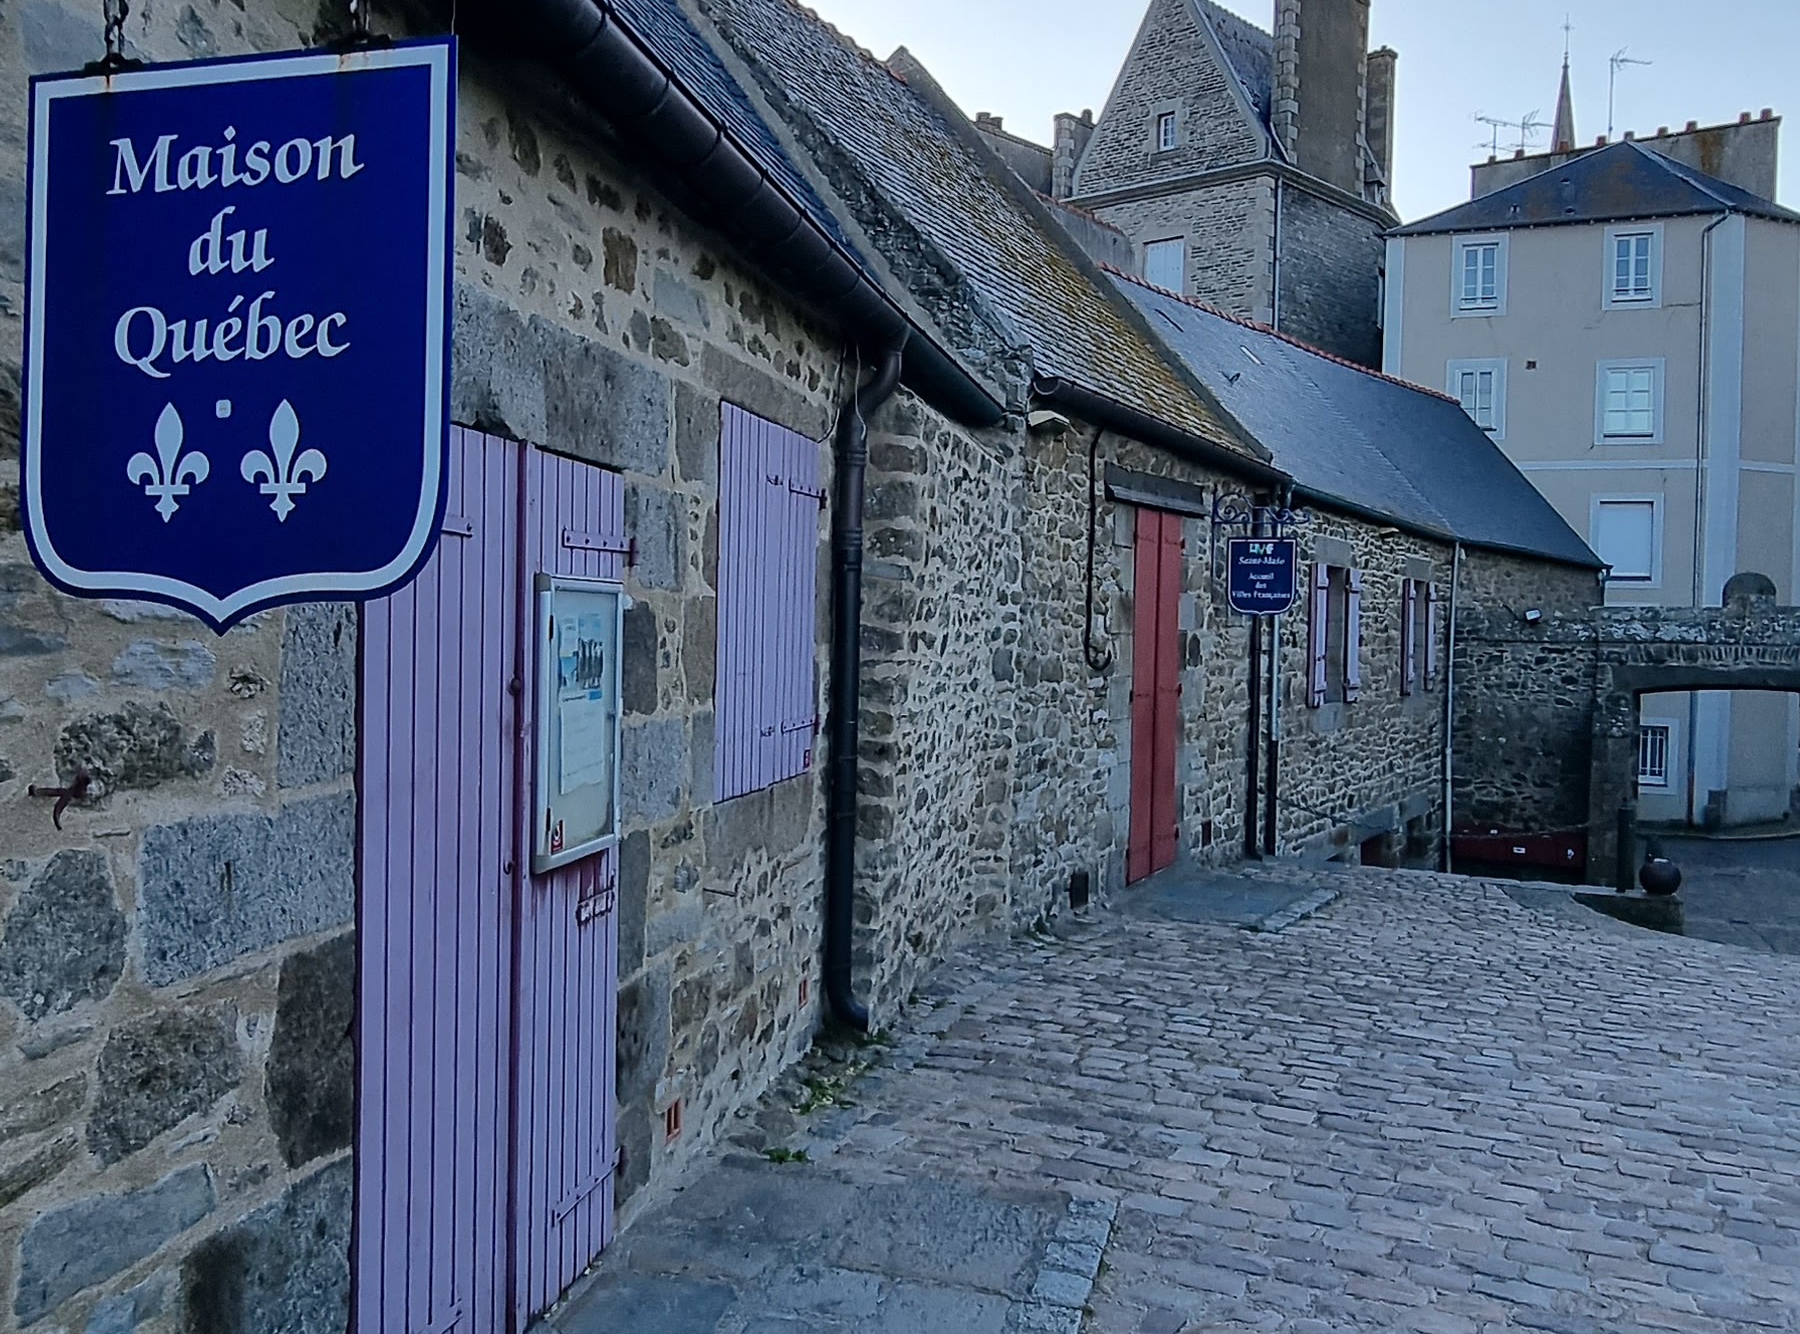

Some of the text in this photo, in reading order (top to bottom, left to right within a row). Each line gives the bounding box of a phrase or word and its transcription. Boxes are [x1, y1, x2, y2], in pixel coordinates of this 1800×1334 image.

[106, 125, 365, 195] Maison
[188, 205, 275, 276] du
[114, 290, 351, 378] Québec
[1238, 556, 1286, 565] Saint-Malo
[1248, 572, 1275, 580] Accueil
[1255, 581, 1267, 589] des
[1231, 590, 1291, 601] Villes Françaises
